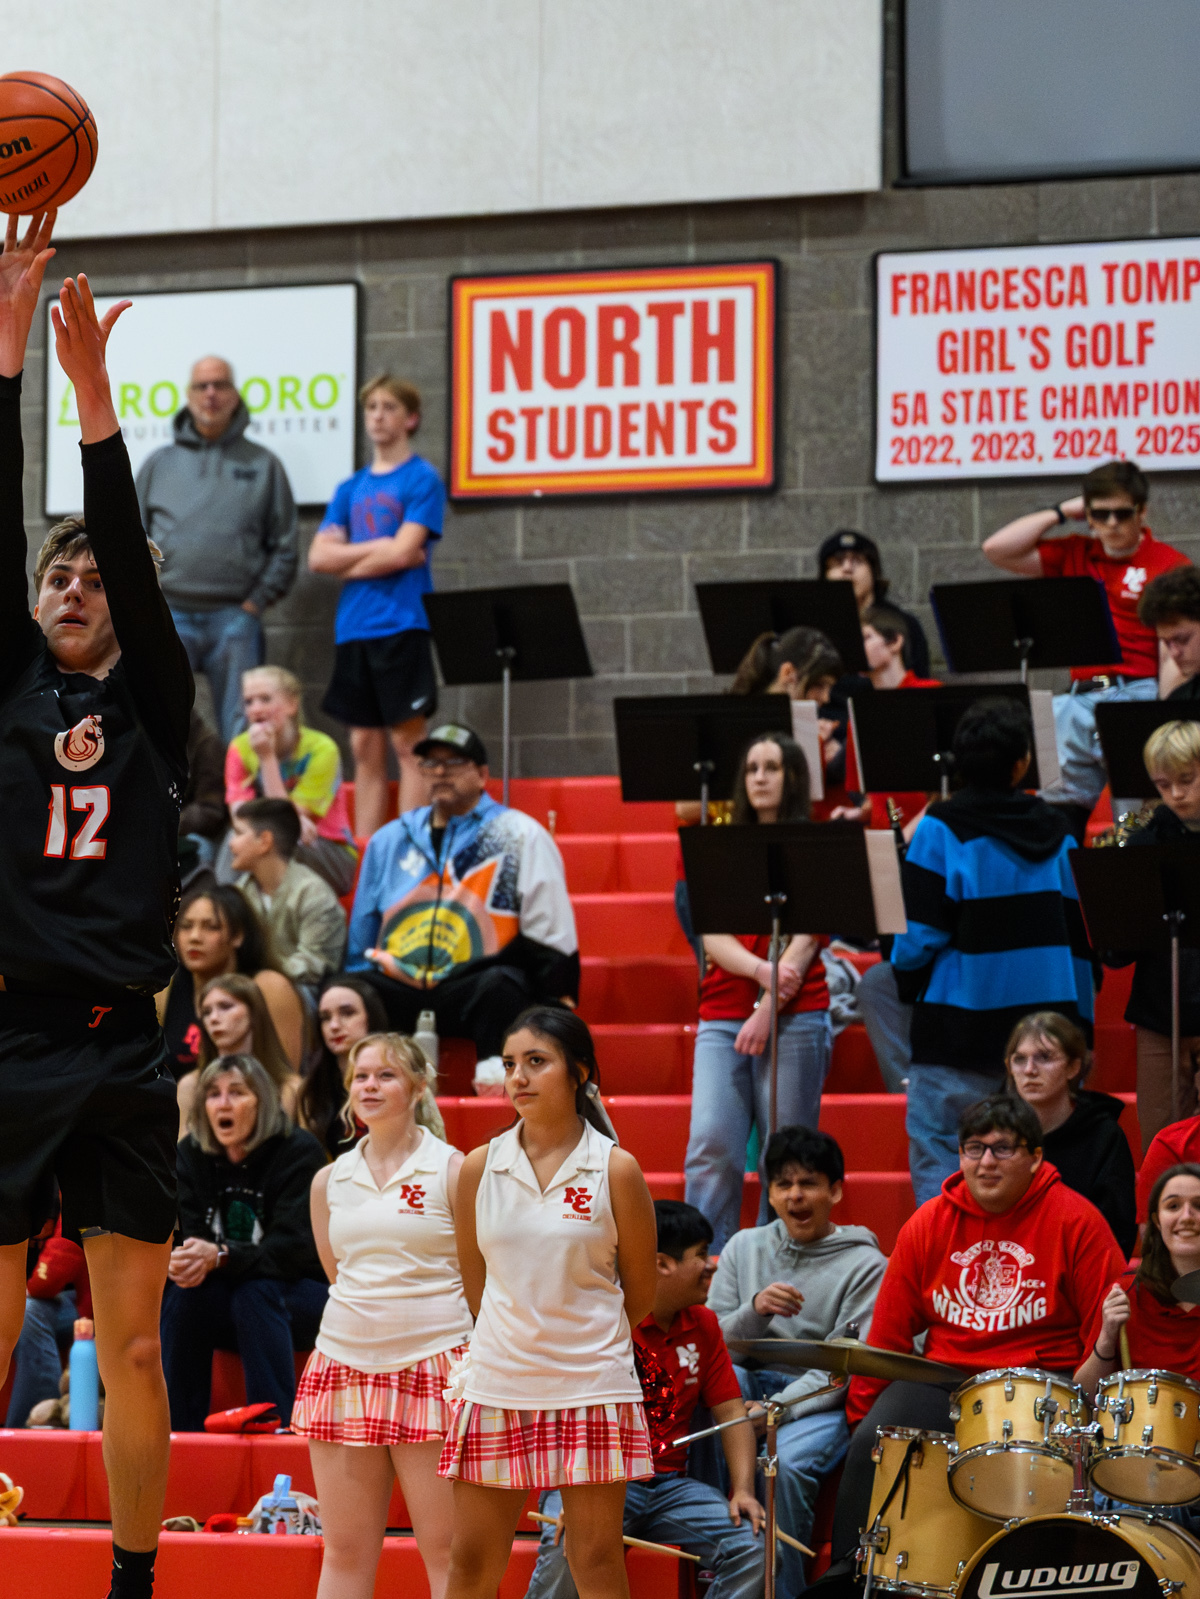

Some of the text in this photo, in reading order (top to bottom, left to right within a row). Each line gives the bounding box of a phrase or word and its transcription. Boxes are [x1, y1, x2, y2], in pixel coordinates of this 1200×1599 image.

[891, 264, 1088, 316] FRANCESCA
[490, 298, 736, 393] NORTH
[937, 319, 1155, 375] GIRL'S GOLF
[119, 373, 339, 419] ROORO
[891, 391, 928, 427] 5A
[941, 386, 1028, 425] STATE
[487, 398, 738, 463] STUDENTS
[890, 424, 1200, 466] 2022, 2023, 2024, 2025
[43, 784, 111, 860] 12
[932, 1289, 1047, 1332] WRESTLING
